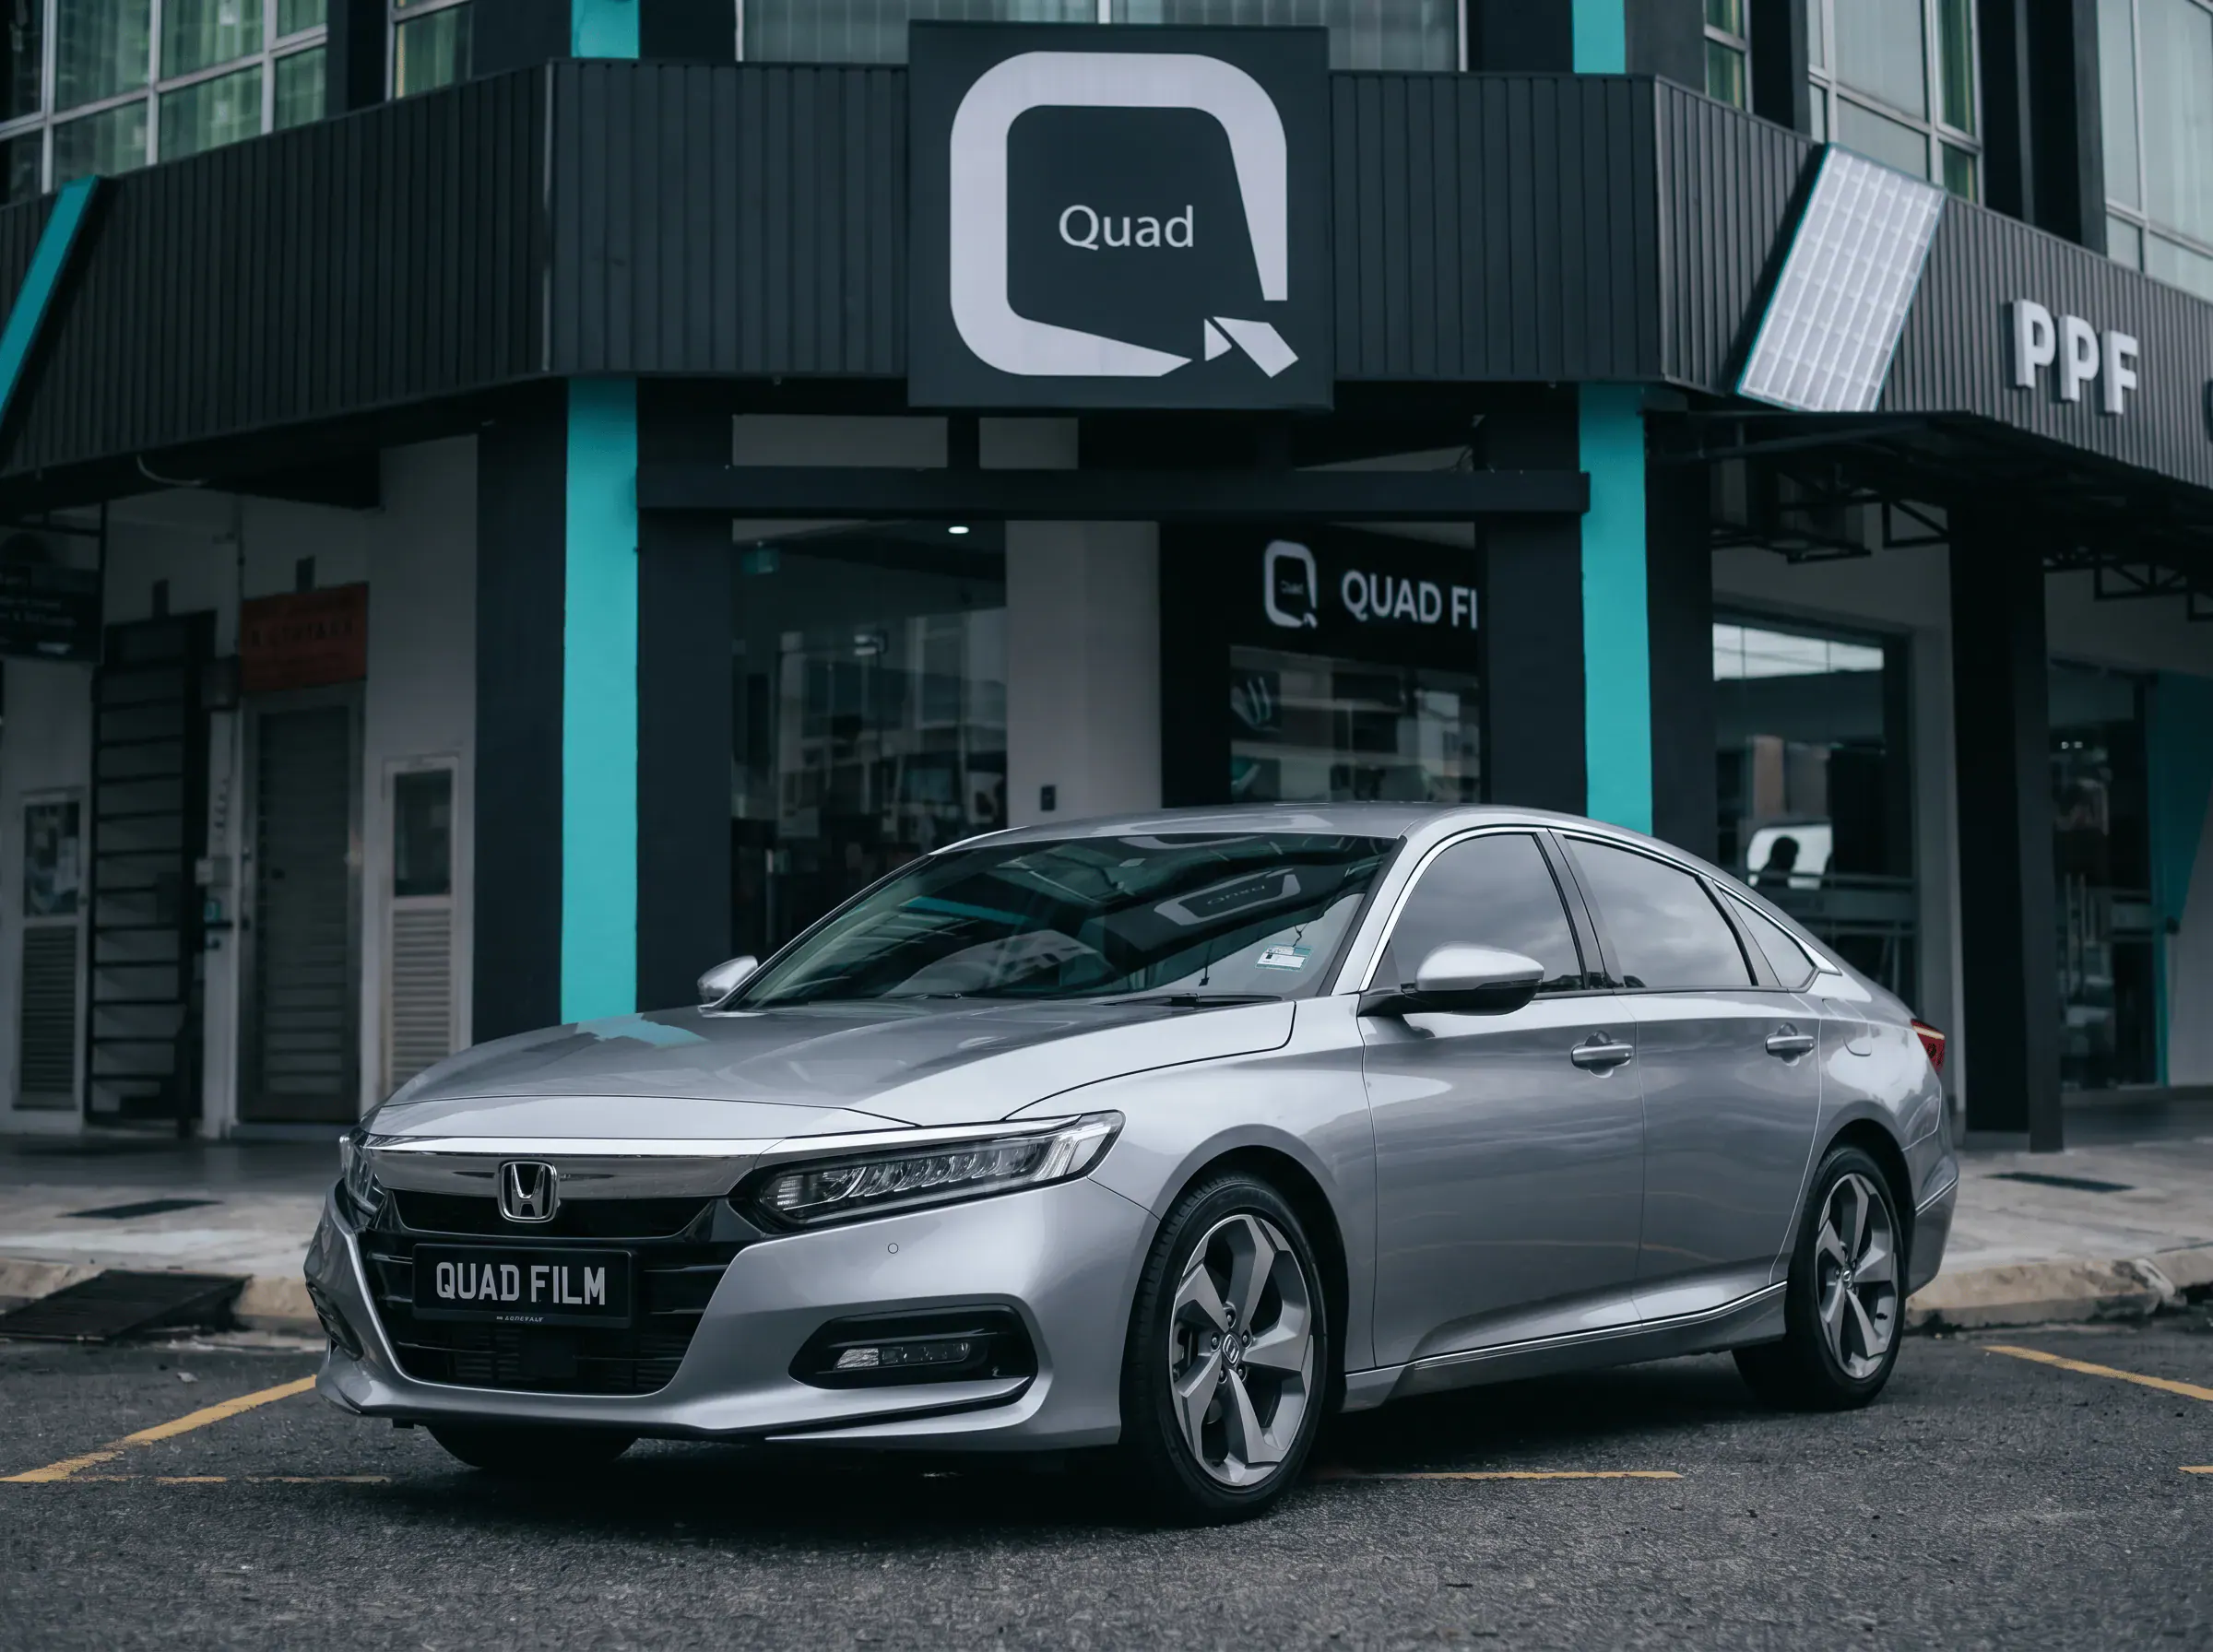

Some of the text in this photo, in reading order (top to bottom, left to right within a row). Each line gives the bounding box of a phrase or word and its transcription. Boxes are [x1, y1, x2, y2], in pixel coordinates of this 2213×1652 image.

[1059, 205, 1194, 251] Quad
[2013, 299, 2138, 415] PPF
[1342, 569, 1477, 630] QUAD FI
[436, 1261, 606, 1305] QUAD FILM
